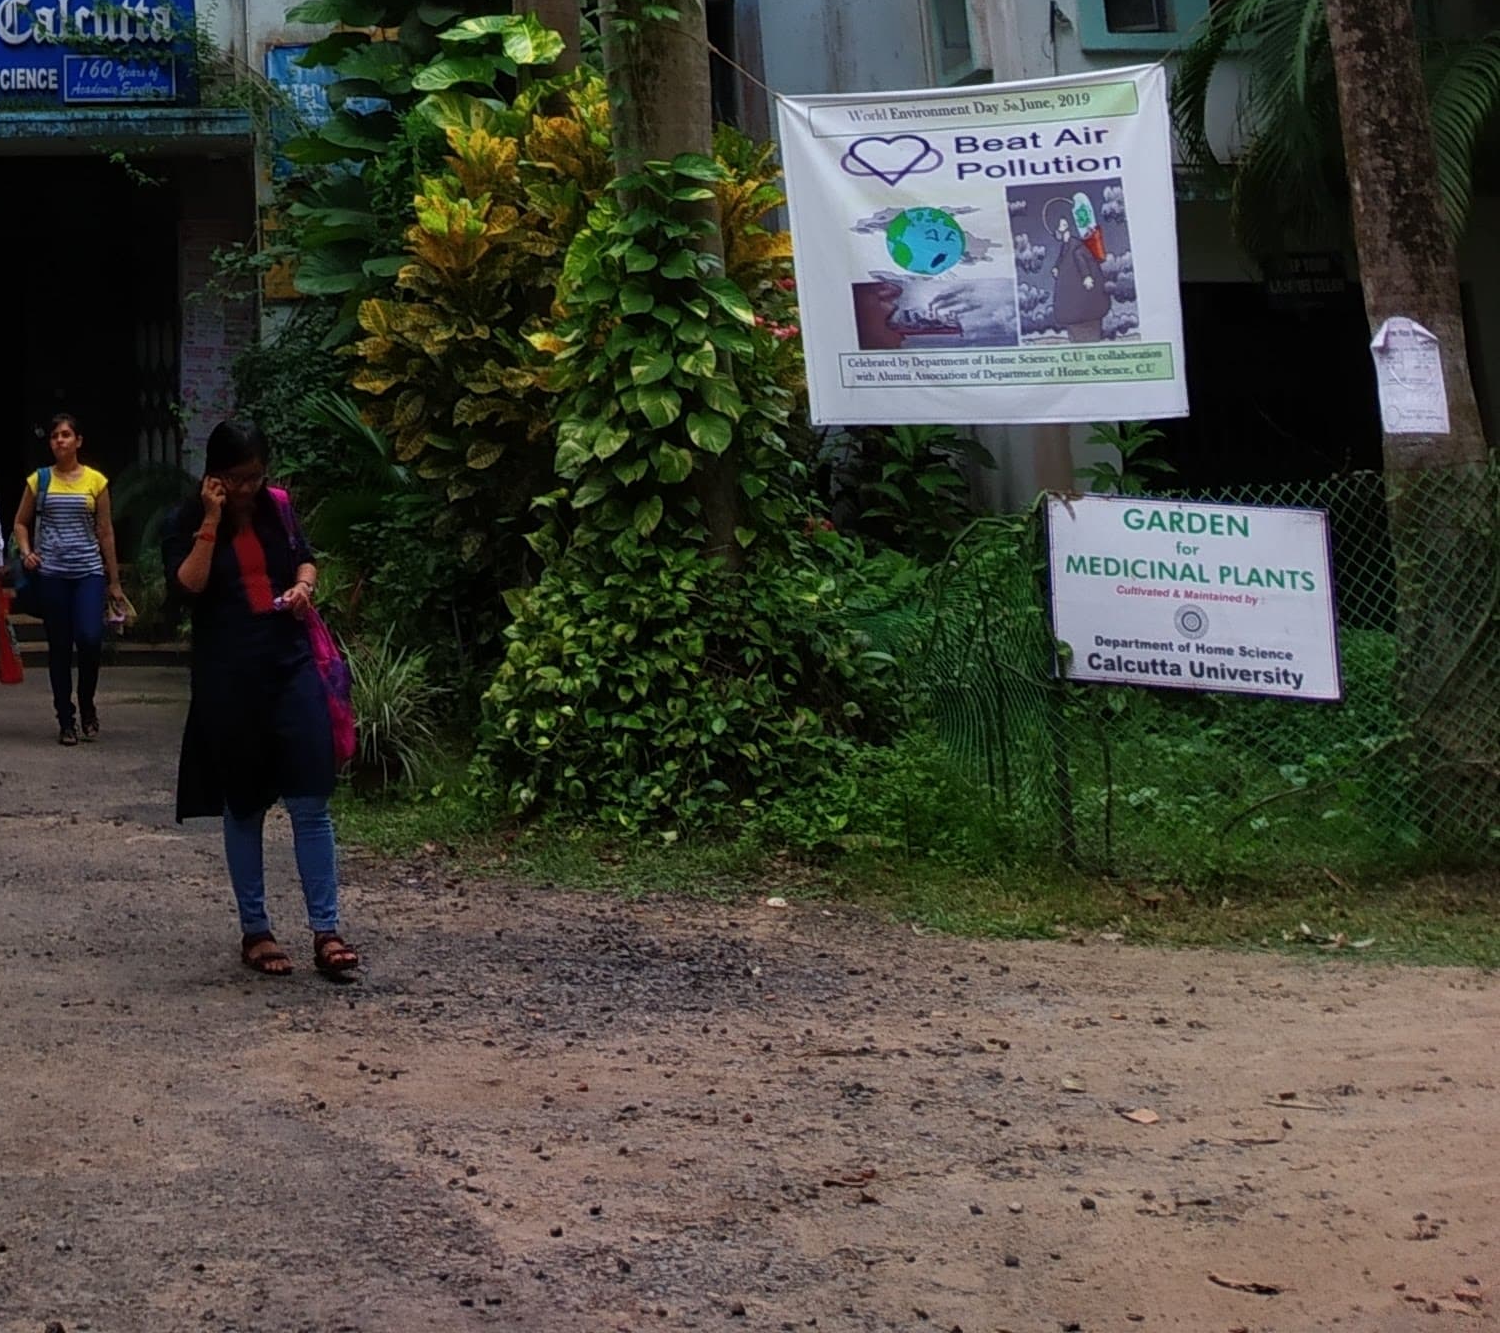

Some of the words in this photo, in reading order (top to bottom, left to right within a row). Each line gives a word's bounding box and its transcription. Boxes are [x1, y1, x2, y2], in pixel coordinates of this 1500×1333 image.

[79, 60, 113, 79] 160
[848, 108, 887, 122] World
[889, 104, 971, 120] Environment
[974, 101, 998, 117] Day
[1019, 96, 1055, 113] June,
[1058, 93, 1091, 107] 2019
[954, 132, 1042, 154] Beat
[1054, 127, 1109, 147] Air
[956, 154, 1121, 180] Pollution
[847, 356, 896, 368] Celebrated
[899, 356, 909, 369] by
[912, 355, 969, 368] Department
[971, 354, 982, 365] of
[985, 354, 1015, 365] Home
[1018, 353, 1058, 365] Science,
[1085, 351, 1095, 362] in
[1097, 349, 1162, 361] collaboration
[856, 371, 875, 382] with
[877, 370, 911, 382] Alumni
[914, 369, 967, 381] Association
[970, 369, 981, 380] of
[983, 368, 1042, 381] Department
[1044, 367, 1056, 378] of
[1057, 366, 1089, 377] Home
[1091, 364, 1133, 376] Science,
[1123, 507, 1250, 538] GARDEN
[1176, 541, 1199, 555] for
[1065, 555, 1211, 584] MEDICINAL
[1219, 565, 1316, 592] PLANTS
[1116, 585, 1170, 598] Cultivated
[1172, 589, 1181, 598] &
[1183, 589, 1242, 604] Maintained
[1244, 593, 1258, 606] by
[1094, 635, 1174, 653] Department
[1177, 641, 1191, 653] of
[1195, 643, 1234, 657] Home
[1239, 645, 1294, 661] Science
[1087, 653, 1182, 677] Calcutta
[1189, 660, 1304, 690] University
